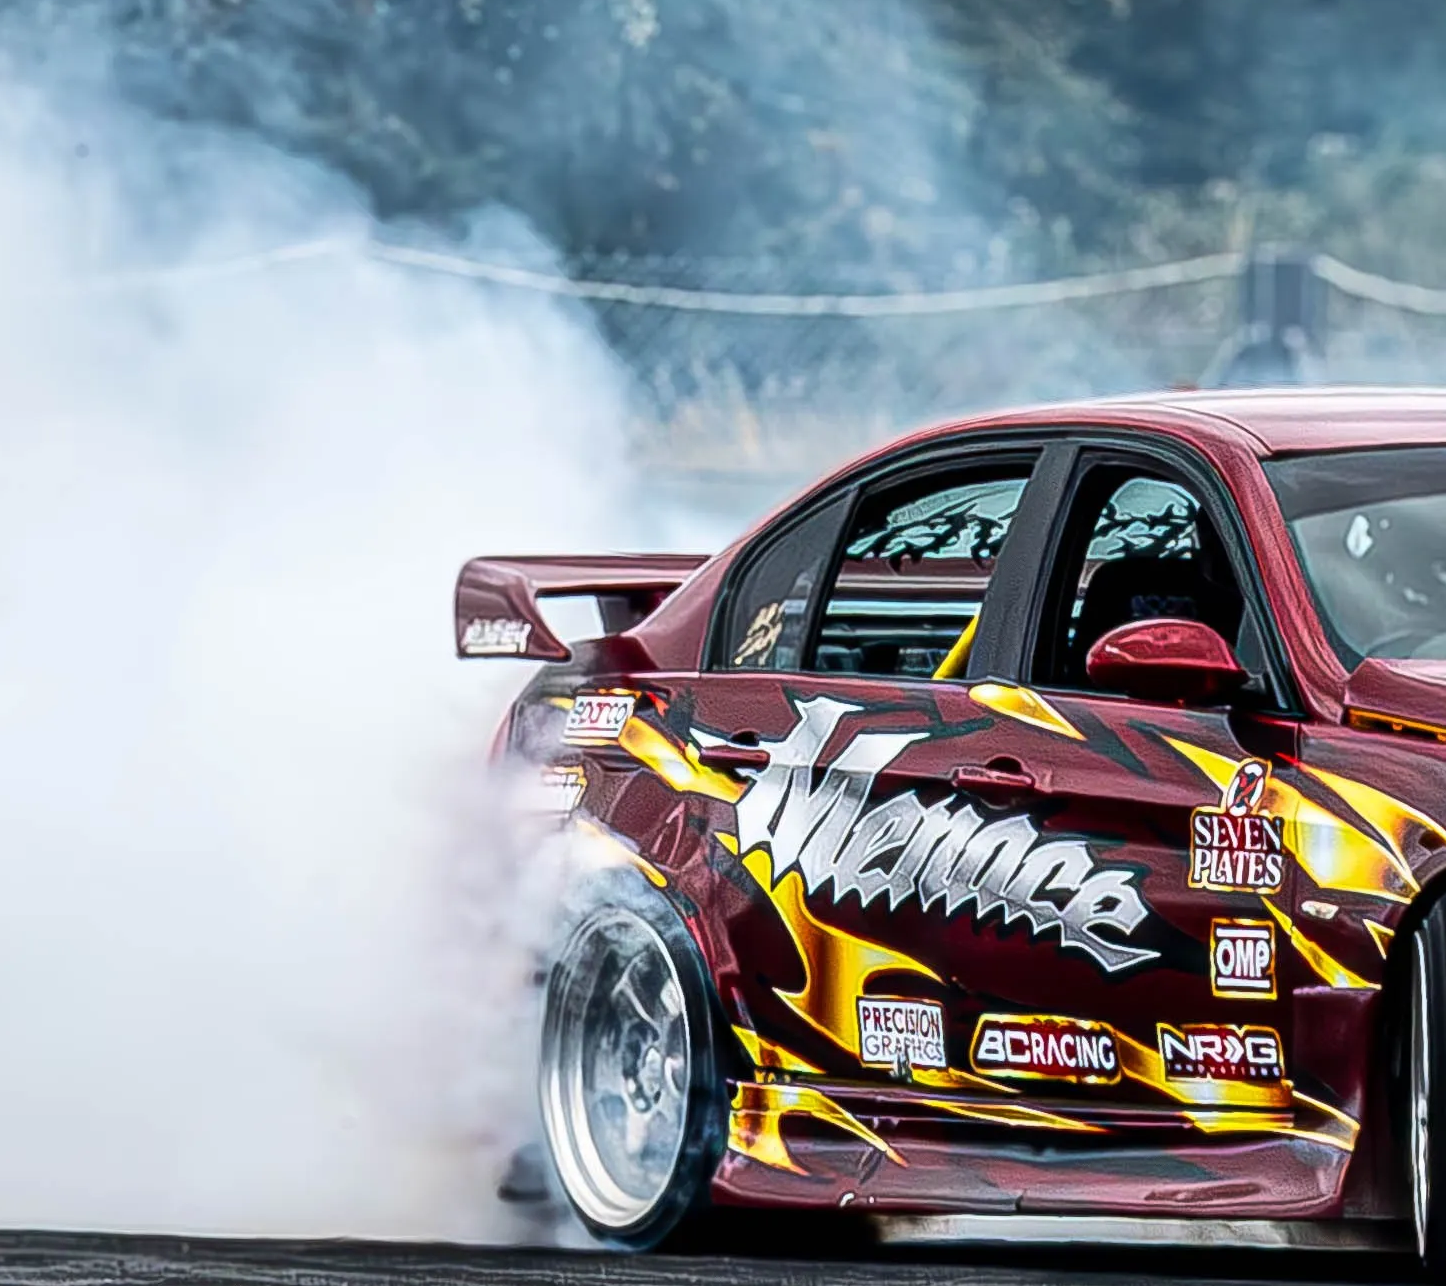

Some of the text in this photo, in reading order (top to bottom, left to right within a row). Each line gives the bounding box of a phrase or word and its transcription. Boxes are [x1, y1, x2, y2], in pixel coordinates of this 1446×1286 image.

[690, 696, 1161, 973] Menace
[1194, 815, 1281, 850] SEVEN
[1194, 848, 1283, 886] PLATES
[1216, 939, 1270, 978] OMP
[862, 1006, 941, 1040] PRECISION
[865, 1034, 944, 1061] GRAPHCS
